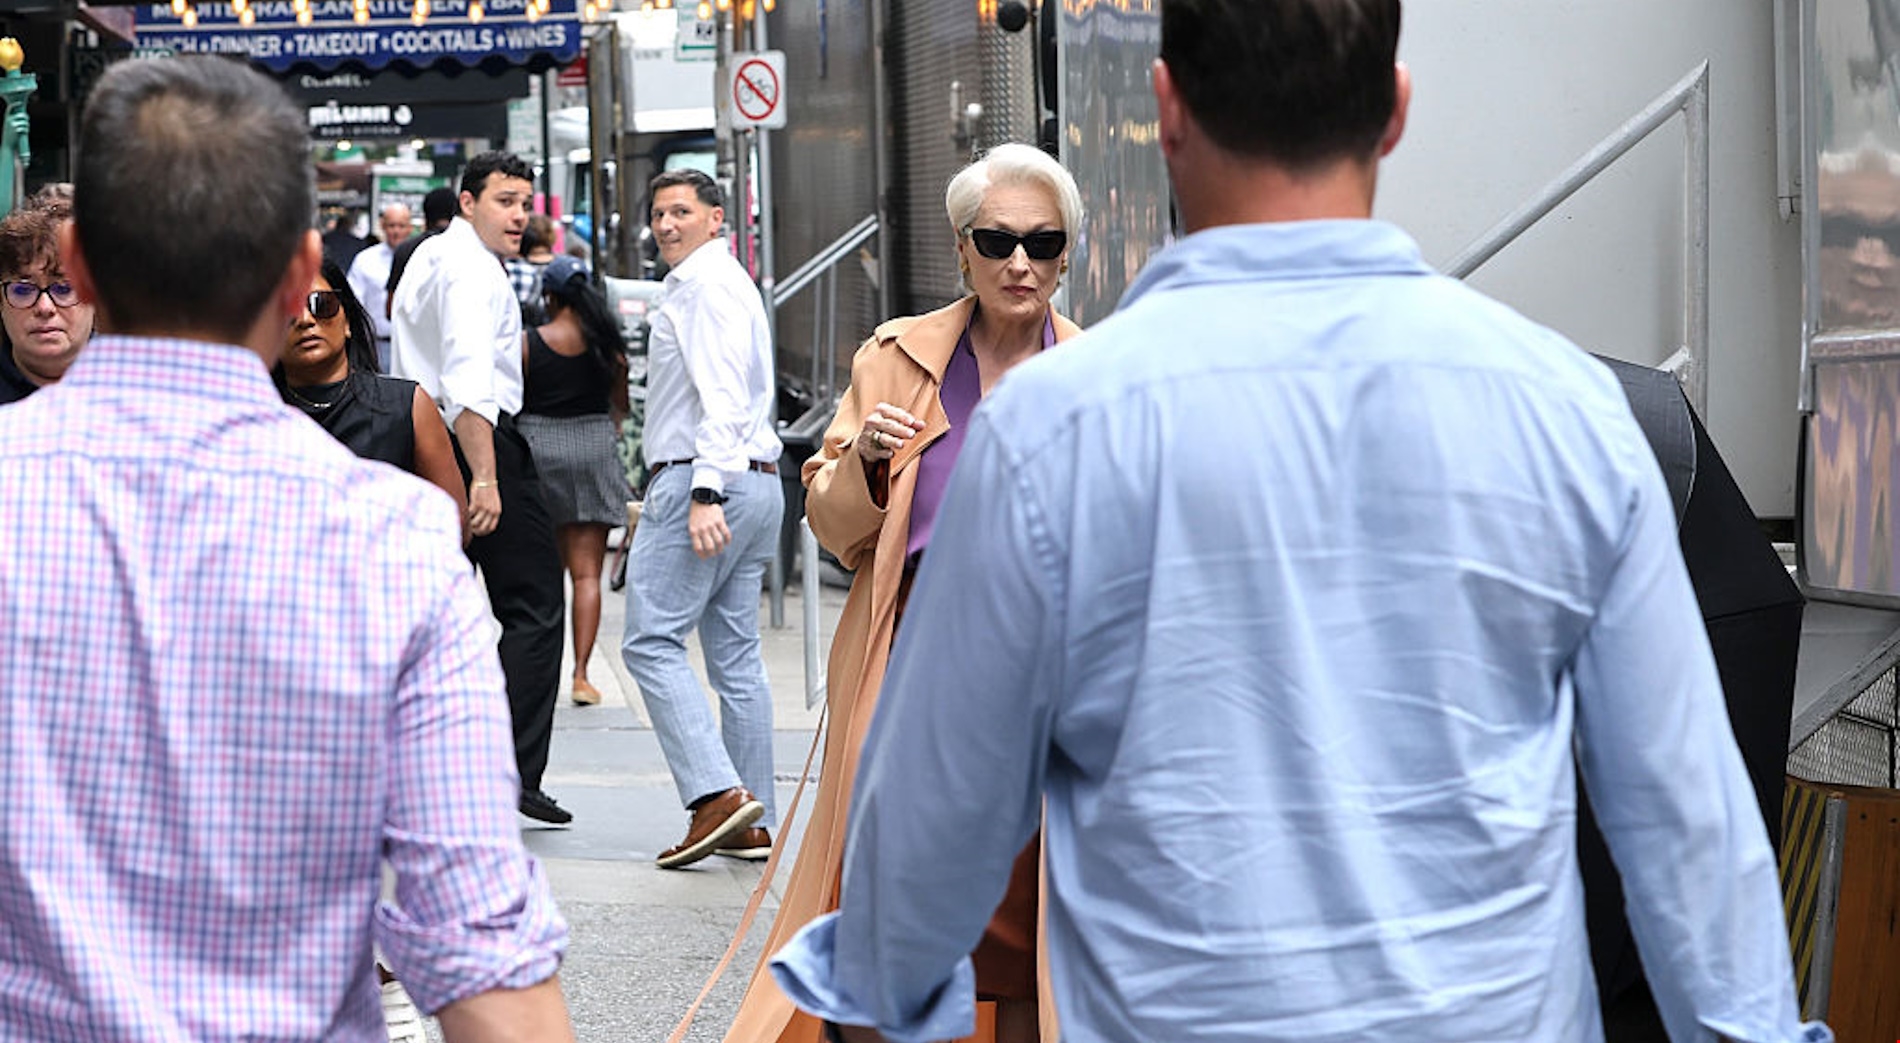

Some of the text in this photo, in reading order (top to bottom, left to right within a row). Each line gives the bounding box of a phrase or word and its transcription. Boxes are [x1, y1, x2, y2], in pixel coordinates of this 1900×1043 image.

[210, 34, 282, 57] DINNER
[294, 31, 379, 57] TAKEOUT
[391, 28, 494, 53] COCKTAILS
[504, 25, 567, 49] WINES
